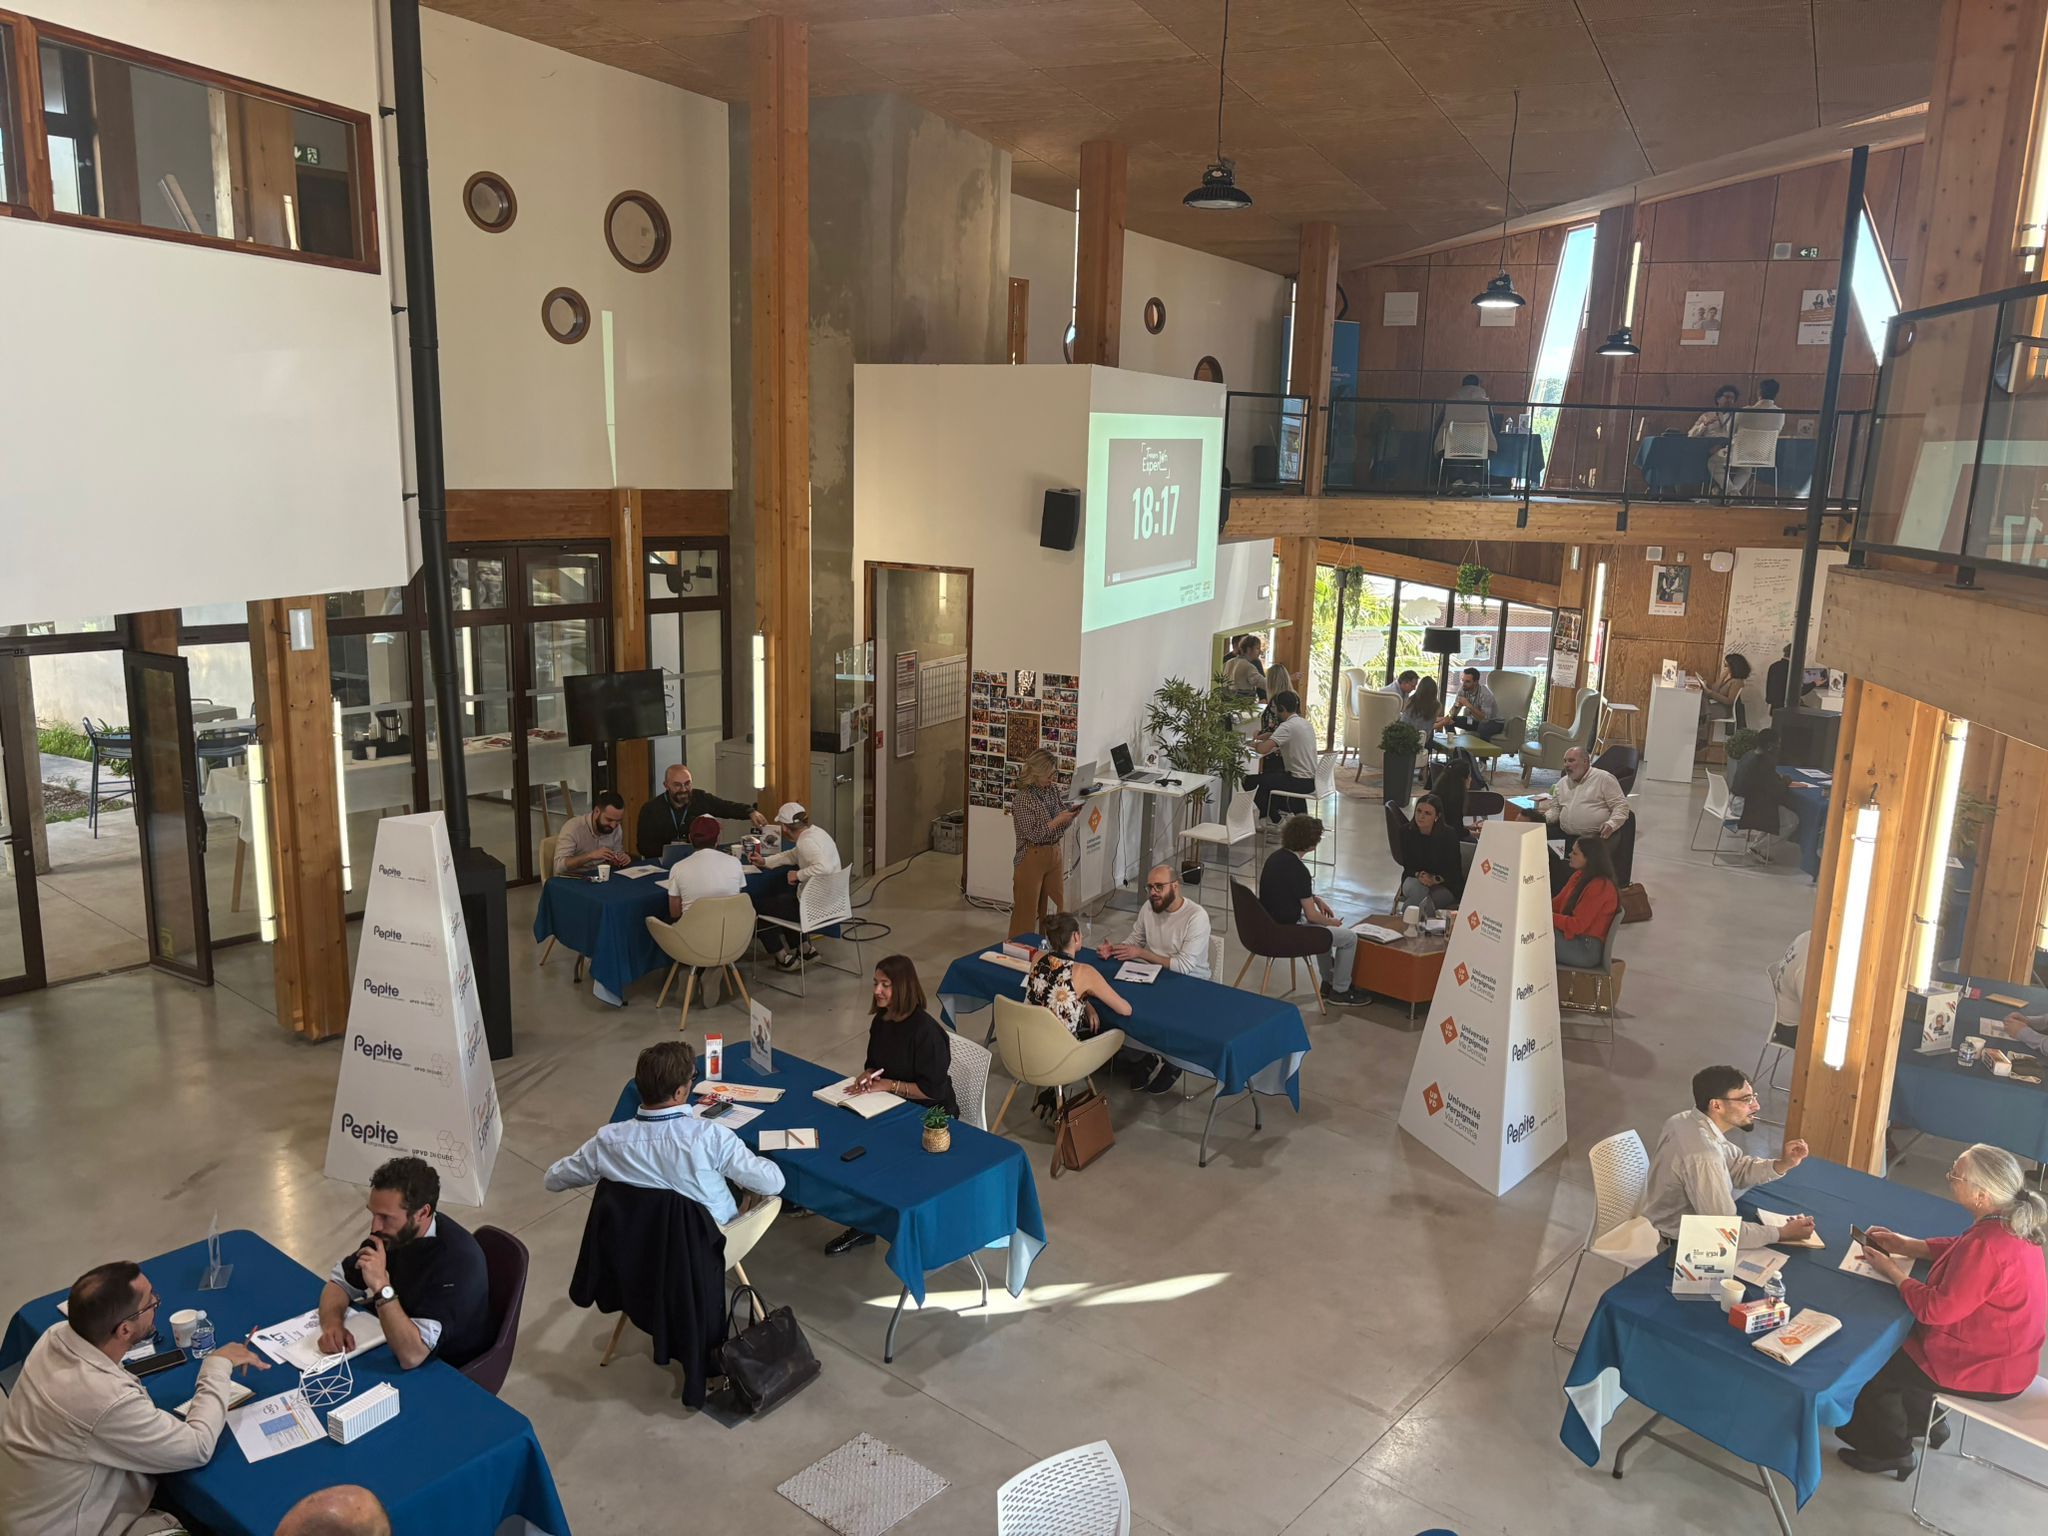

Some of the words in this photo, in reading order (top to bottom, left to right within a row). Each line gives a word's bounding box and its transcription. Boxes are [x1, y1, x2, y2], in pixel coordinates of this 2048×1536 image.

[1132, 485, 1180, 540] 18:17
[379, 864, 401, 876] Pepite
[374, 925, 402, 940] Pepite
[1470, 974, 1496, 992] Perpignan
[1472, 968, 1496, 985] Université
[364, 978, 399, 997] Pepite
[1516, 983, 1534, 1000] Pepite
[1460, 1032, 1488, 1054] Perpignan
[1462, 1024, 1490, 1045] Université
[354, 1035, 402, 1060] Pepite
[1466, 1045, 1487, 1062] Domitia
[1512, 1038, 1536, 1062] Pepite
[1446, 1102, 1479, 1130] Perpignan
[1448, 1092, 1480, 1120] Université
[341, 1113, 398, 1144] Pepite
[1444, 1111, 1454, 1122] Via
[1454, 1118, 1478, 1140] Domitia
[1506, 1114, 1535, 1144] Pepite
[412, 1148, 428, 1157] UPVD
